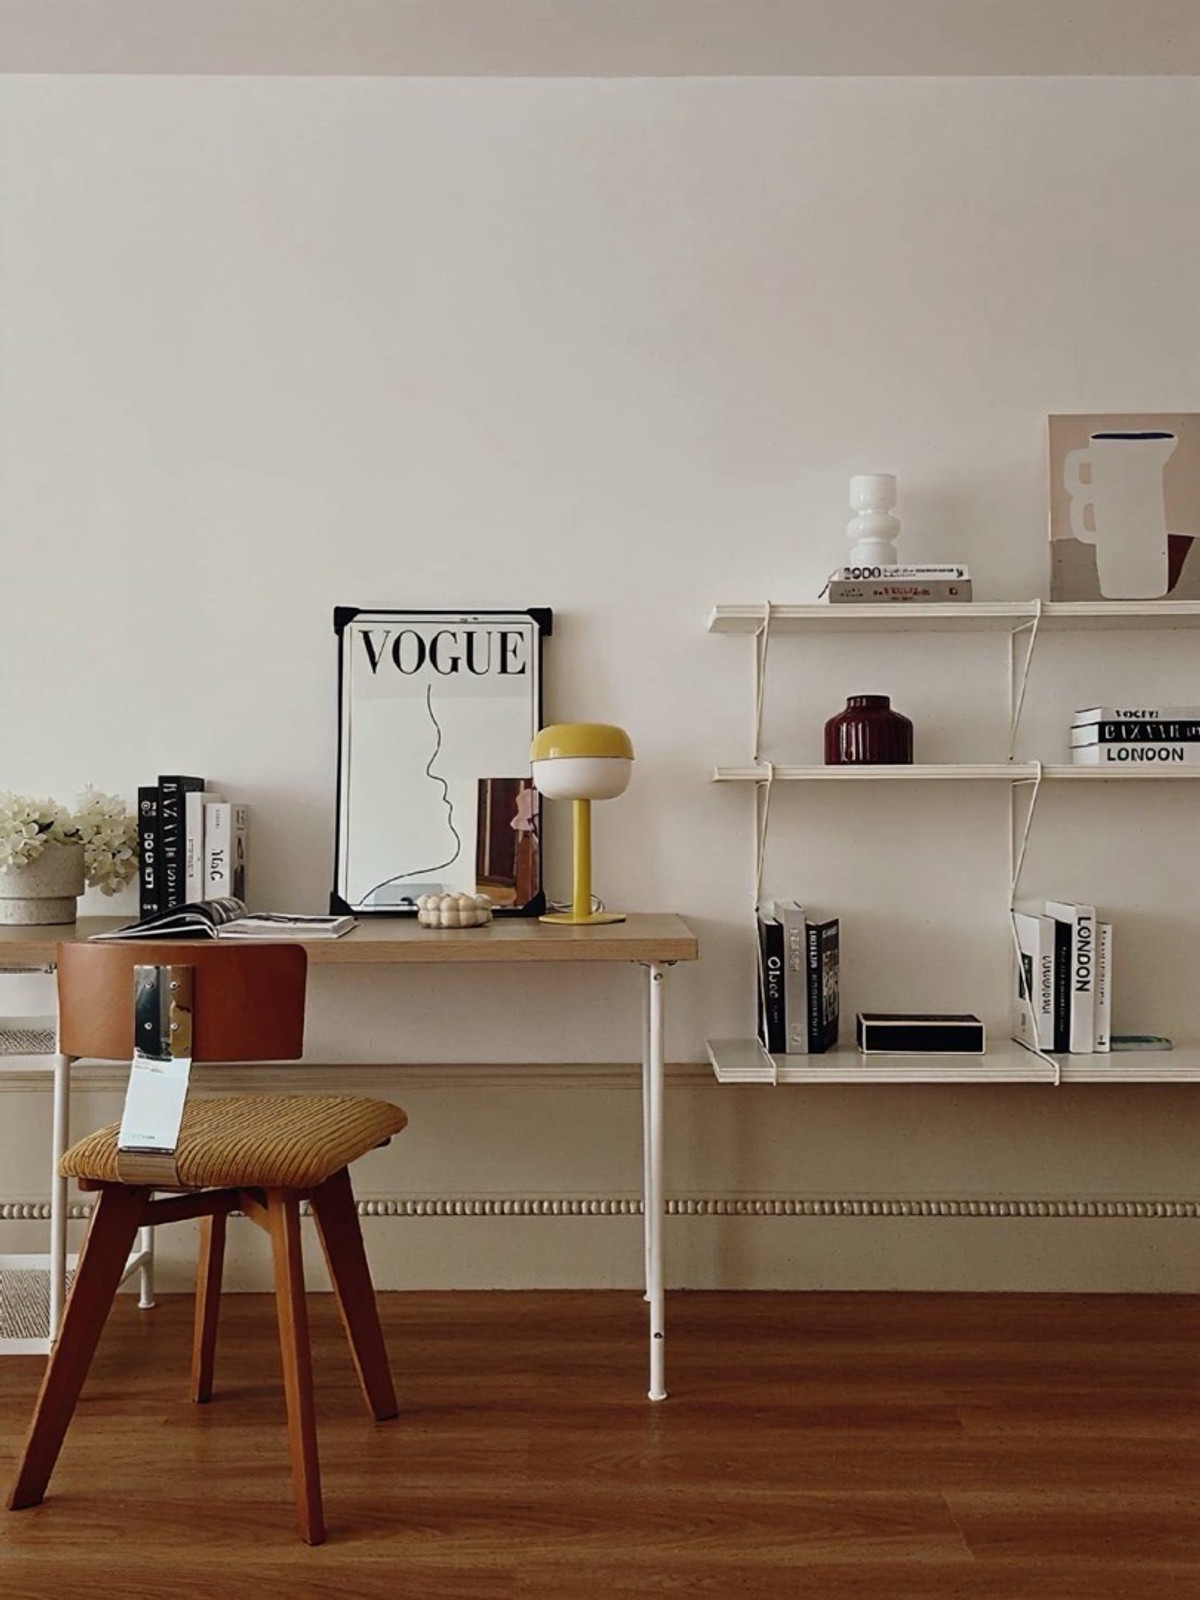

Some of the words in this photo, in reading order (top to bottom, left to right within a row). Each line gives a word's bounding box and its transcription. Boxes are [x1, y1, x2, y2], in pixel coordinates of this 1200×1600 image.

[357, 629, 526, 676] VOGUE
[1106, 747, 1184, 762] LONDON
[1075, 916, 1092, 993] LONDON
